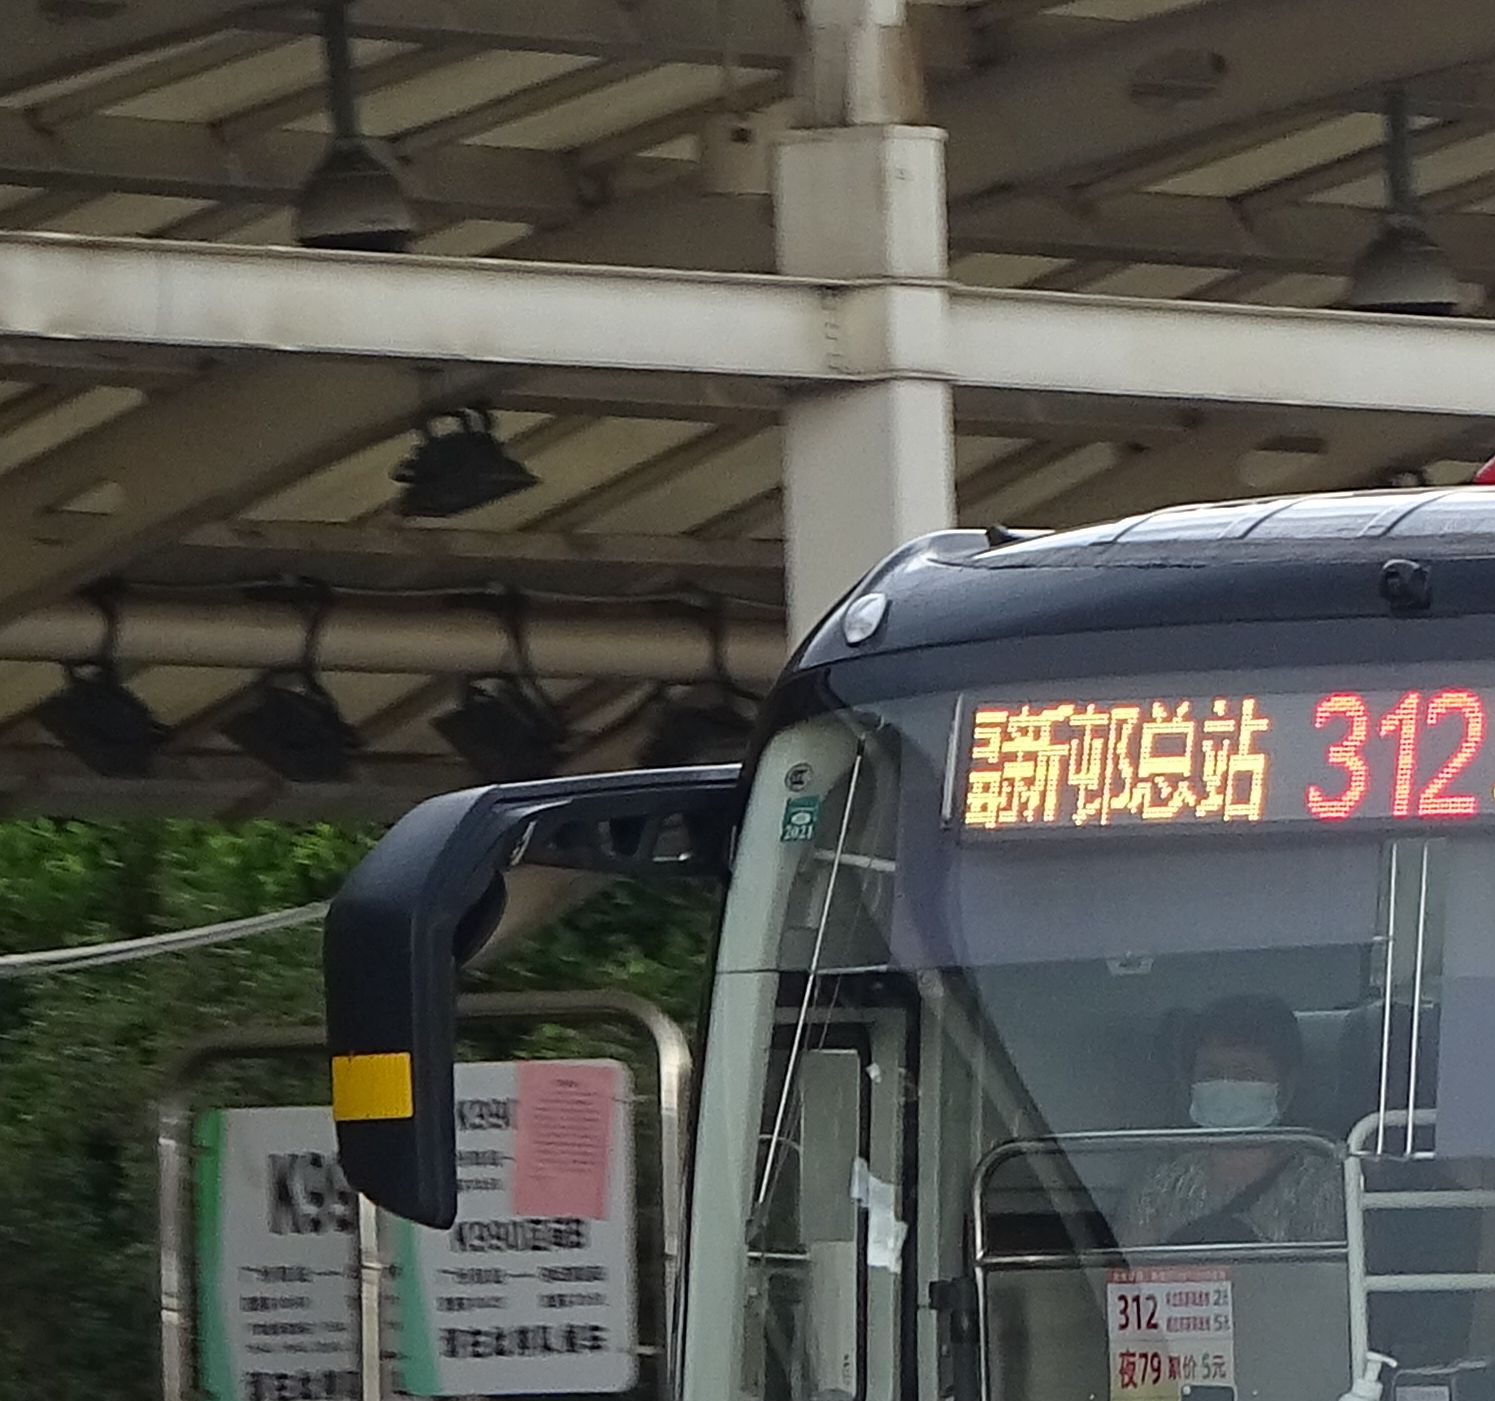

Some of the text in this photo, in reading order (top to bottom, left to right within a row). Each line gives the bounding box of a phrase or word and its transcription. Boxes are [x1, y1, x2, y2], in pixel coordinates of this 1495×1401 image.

[1308, 691, 1487, 820] 312
[784, 825, 813, 841] 2021
[1117, 1293, 1159, 1331] 312
[1118, 1348, 1162, 1389] 夜79
